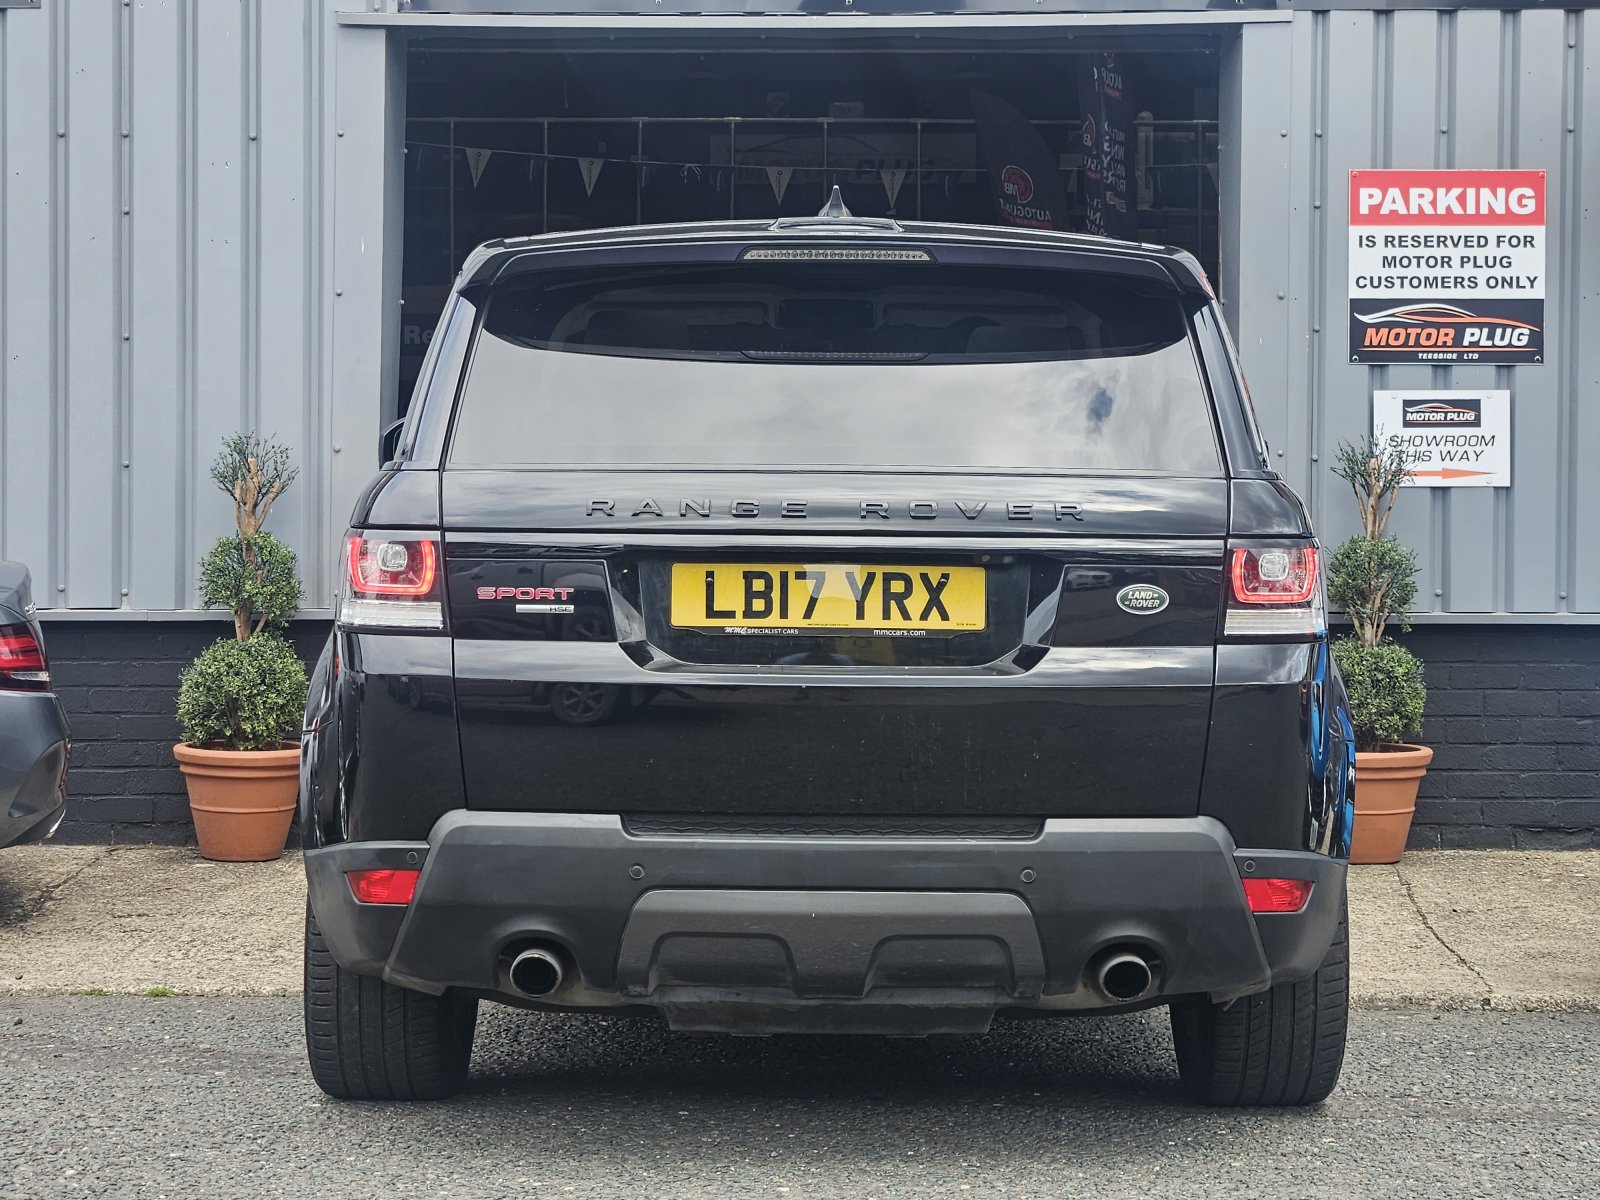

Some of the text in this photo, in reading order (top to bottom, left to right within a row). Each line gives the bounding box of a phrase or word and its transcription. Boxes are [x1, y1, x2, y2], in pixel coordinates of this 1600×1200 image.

[1359, 187, 1536, 215] PARKING
[1358, 235, 1536, 248] IS RESERVED FOR
[1382, 255, 1513, 269] MOTOR PLUG
[1355, 276, 1538, 289] CUSTOMERS ONLY
[1364, 327, 1530, 347] MOTOR PLUG
[1406, 412, 1475, 421] MOTOR PLUG
[1388, 435, 1495, 447] SHOWROOM
[1440, 450, 1484, 462] WAY
[585, 497, 1085, 521] RANGE ROVER
[476, 586, 574, 600] SPORT
[705, 570, 950, 621] LB17 YRX
[1128, 591, 1153, 599] LAND
[1130, 599, 1160, 608] ROVER
[873, 629, 926, 637] mmccars.com
